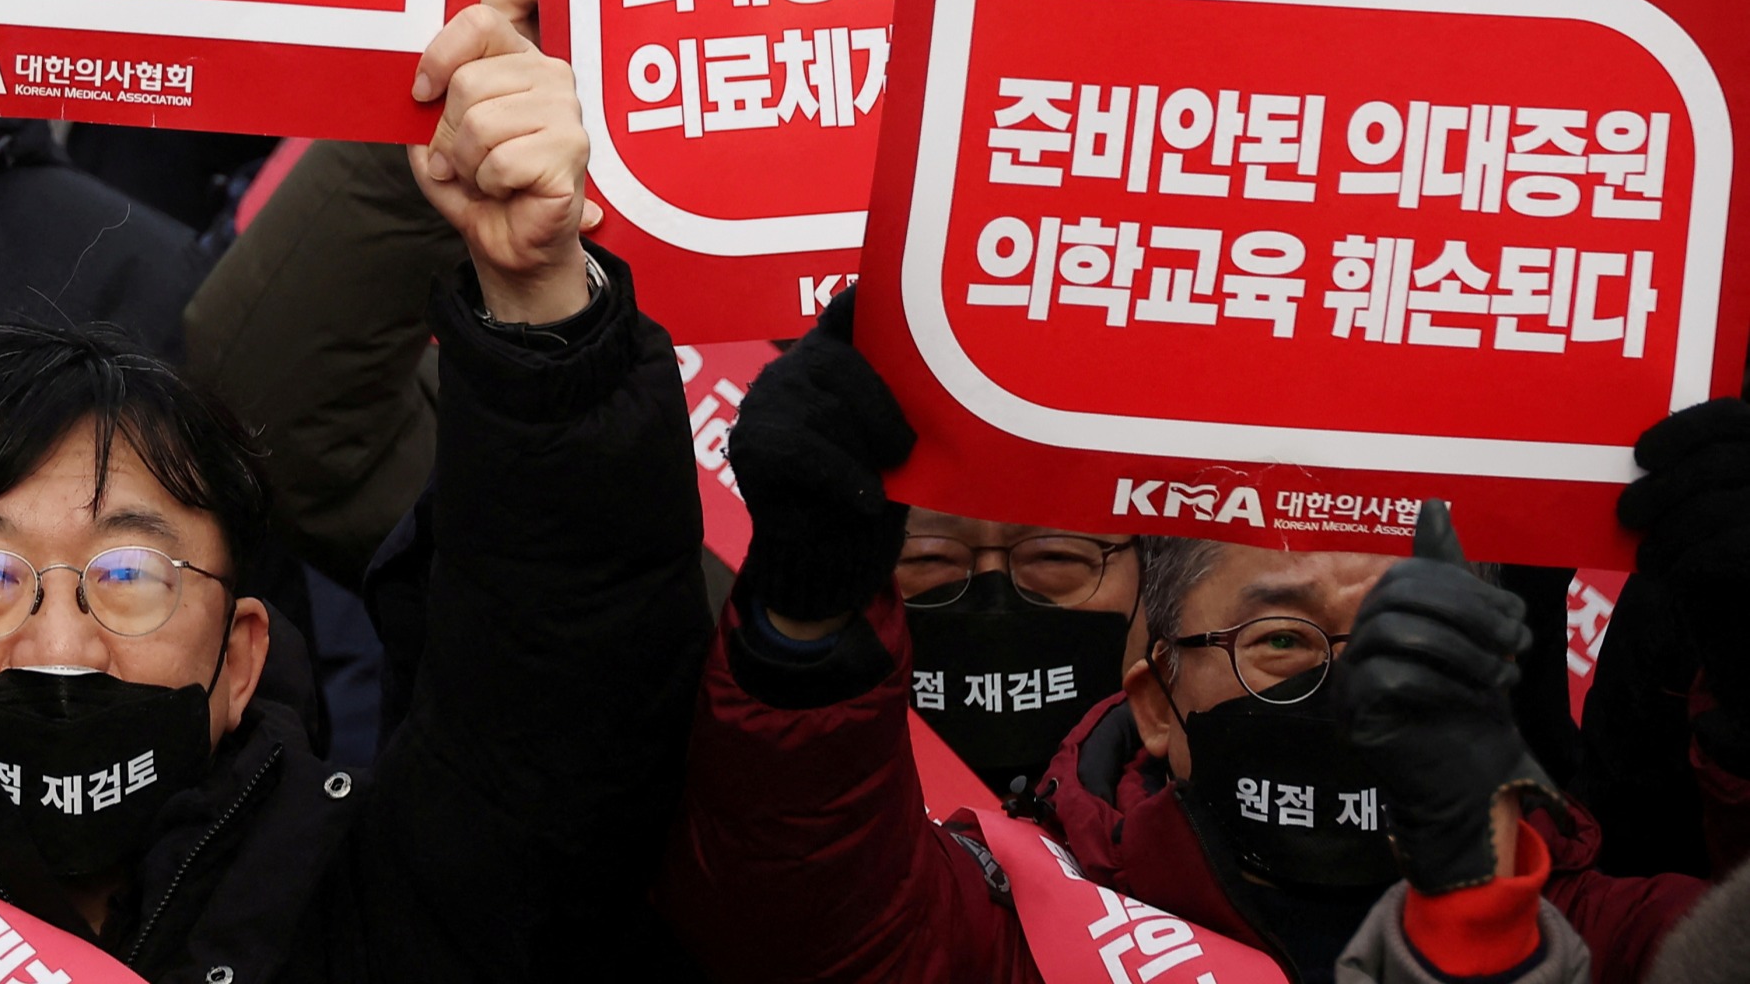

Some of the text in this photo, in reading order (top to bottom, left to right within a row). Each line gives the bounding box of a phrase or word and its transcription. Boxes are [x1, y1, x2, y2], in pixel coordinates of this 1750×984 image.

[14, 53, 194, 93] 대한의사협회
[986, 76, 1672, 221] 준비안된 의대증원
[965, 215, 1659, 359] 의학교육 훼손된다
[1111, 477, 1266, 529] KMA
[1274, 490, 1430, 526] 대한의사협
[963, 665, 1079, 714] 재검토
[39, 749, 158, 815] 재검토
[1235, 776, 1316, 828] 원점
